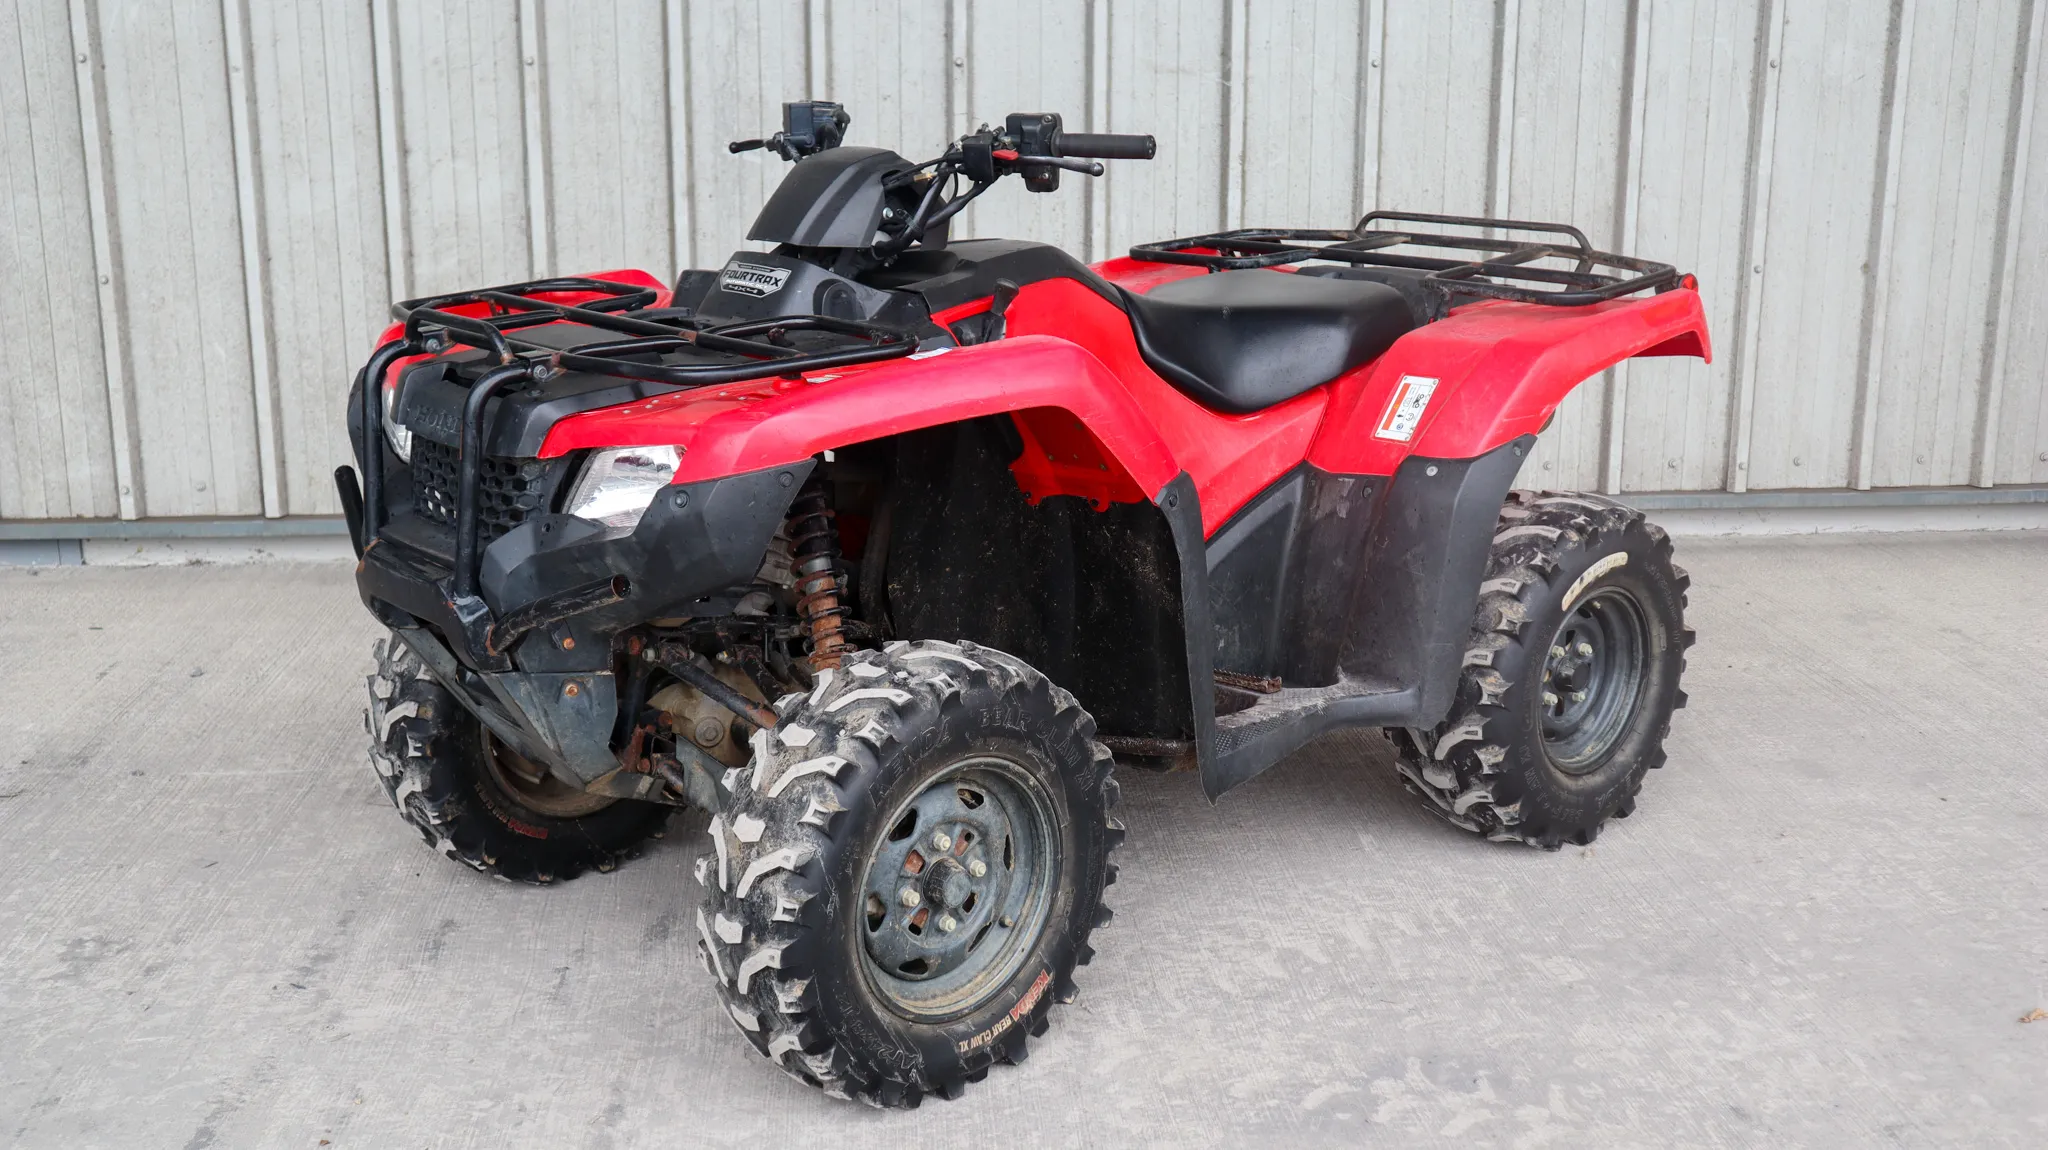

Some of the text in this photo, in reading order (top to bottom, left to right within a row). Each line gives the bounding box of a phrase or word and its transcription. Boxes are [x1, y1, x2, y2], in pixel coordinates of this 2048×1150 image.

[723, 269, 783, 287] FOURTRAX
[1036, 720, 1081, 768] CLAW
[958, 968, 1050, 1053] KENDA BEAR CLAW XL
